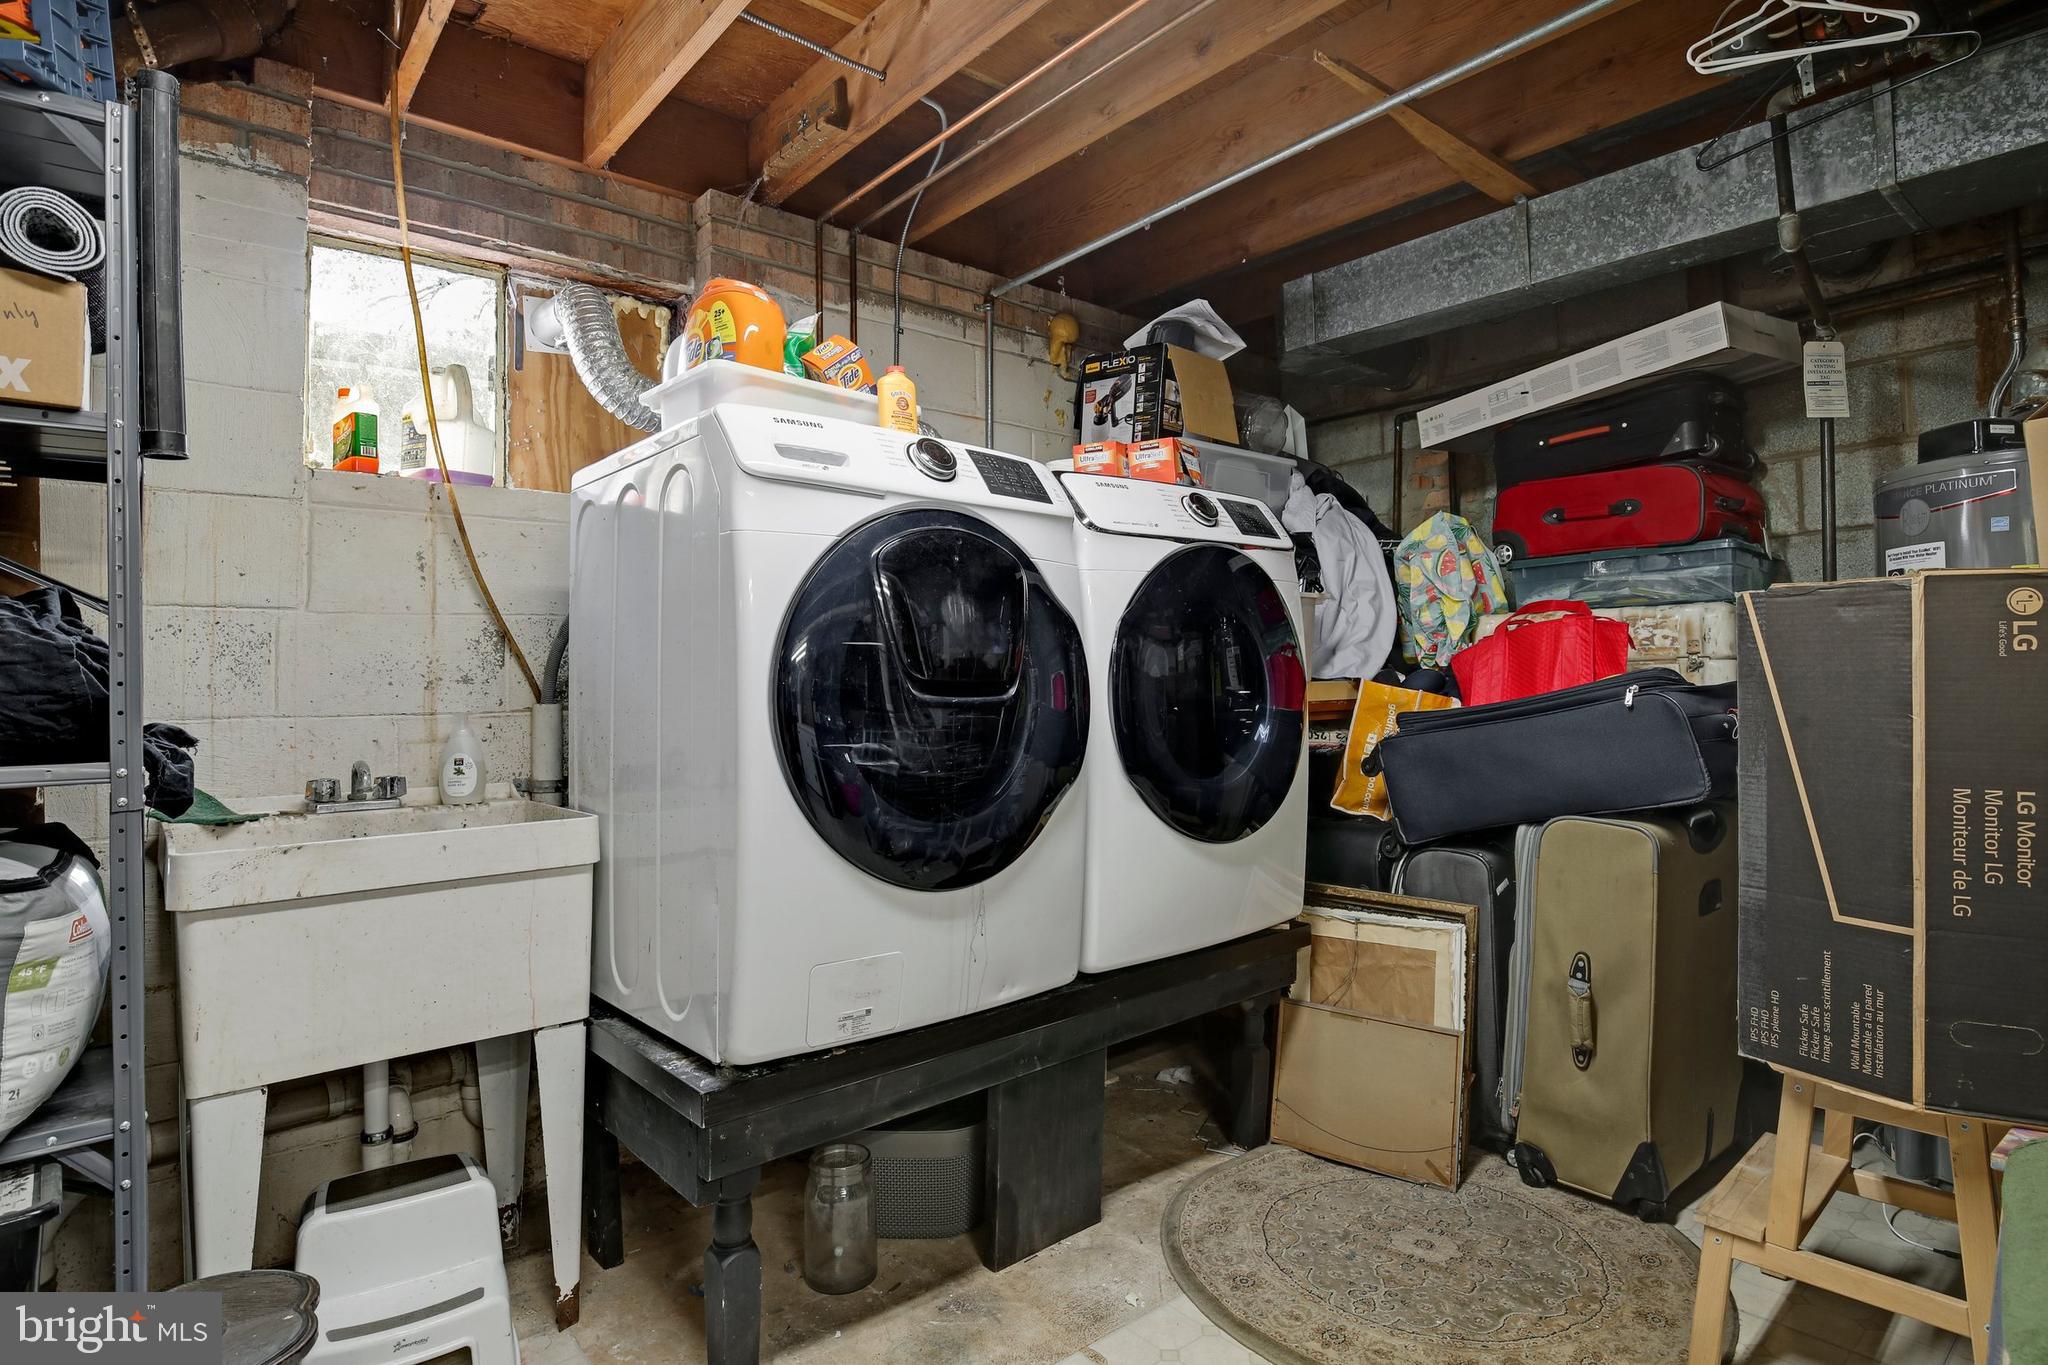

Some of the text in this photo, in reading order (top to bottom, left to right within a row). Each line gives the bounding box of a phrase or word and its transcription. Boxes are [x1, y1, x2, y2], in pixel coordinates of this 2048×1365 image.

[816, 342, 831, 355] Tide
[1101, 355, 1136, 370] FLEXIO
[840, 367, 860, 389] Tide
[772, 416, 824, 429] SAMSUNG
[1135, 448, 1164, 461] UltraSoft
[1095, 481, 1129, 490] SAMSUNG
[1925, 475, 1994, 496] PLATINUM
[1999, 620, 2008, 657] Life's Good
[2012, 621, 2038, 651] LG
[1952, 788, 1972, 917] Moniteur de LG
[1984, 789, 2004, 885] Monitor LG
[2016, 791, 2036, 888] LG Monitor
[17, 966, 33, 977] 45
[1821, 950, 1833, 1063] Image sans scintillement
[1863, 983, 1875, 1011] pared
[1750, 1006, 1759, 1042] IPS FHD
[1760, 1009, 1769, 1046] IPS FHD
[1770, 990, 1781, 1049] IPS pleine HD
[1799, 1003, 1809, 1057] Flicker Safe
[1810, 1006, 1820, 1061] Flicker Safe
[1863, 1013, 1873, 1022] la
[1878, 1013, 1884, 1023] au
[1850, 1001, 1861, 1071] Wall Mountable
[1862, 1033, 1873, 1075] Montable
[1874, 1026, 1884, 1078] Installation
